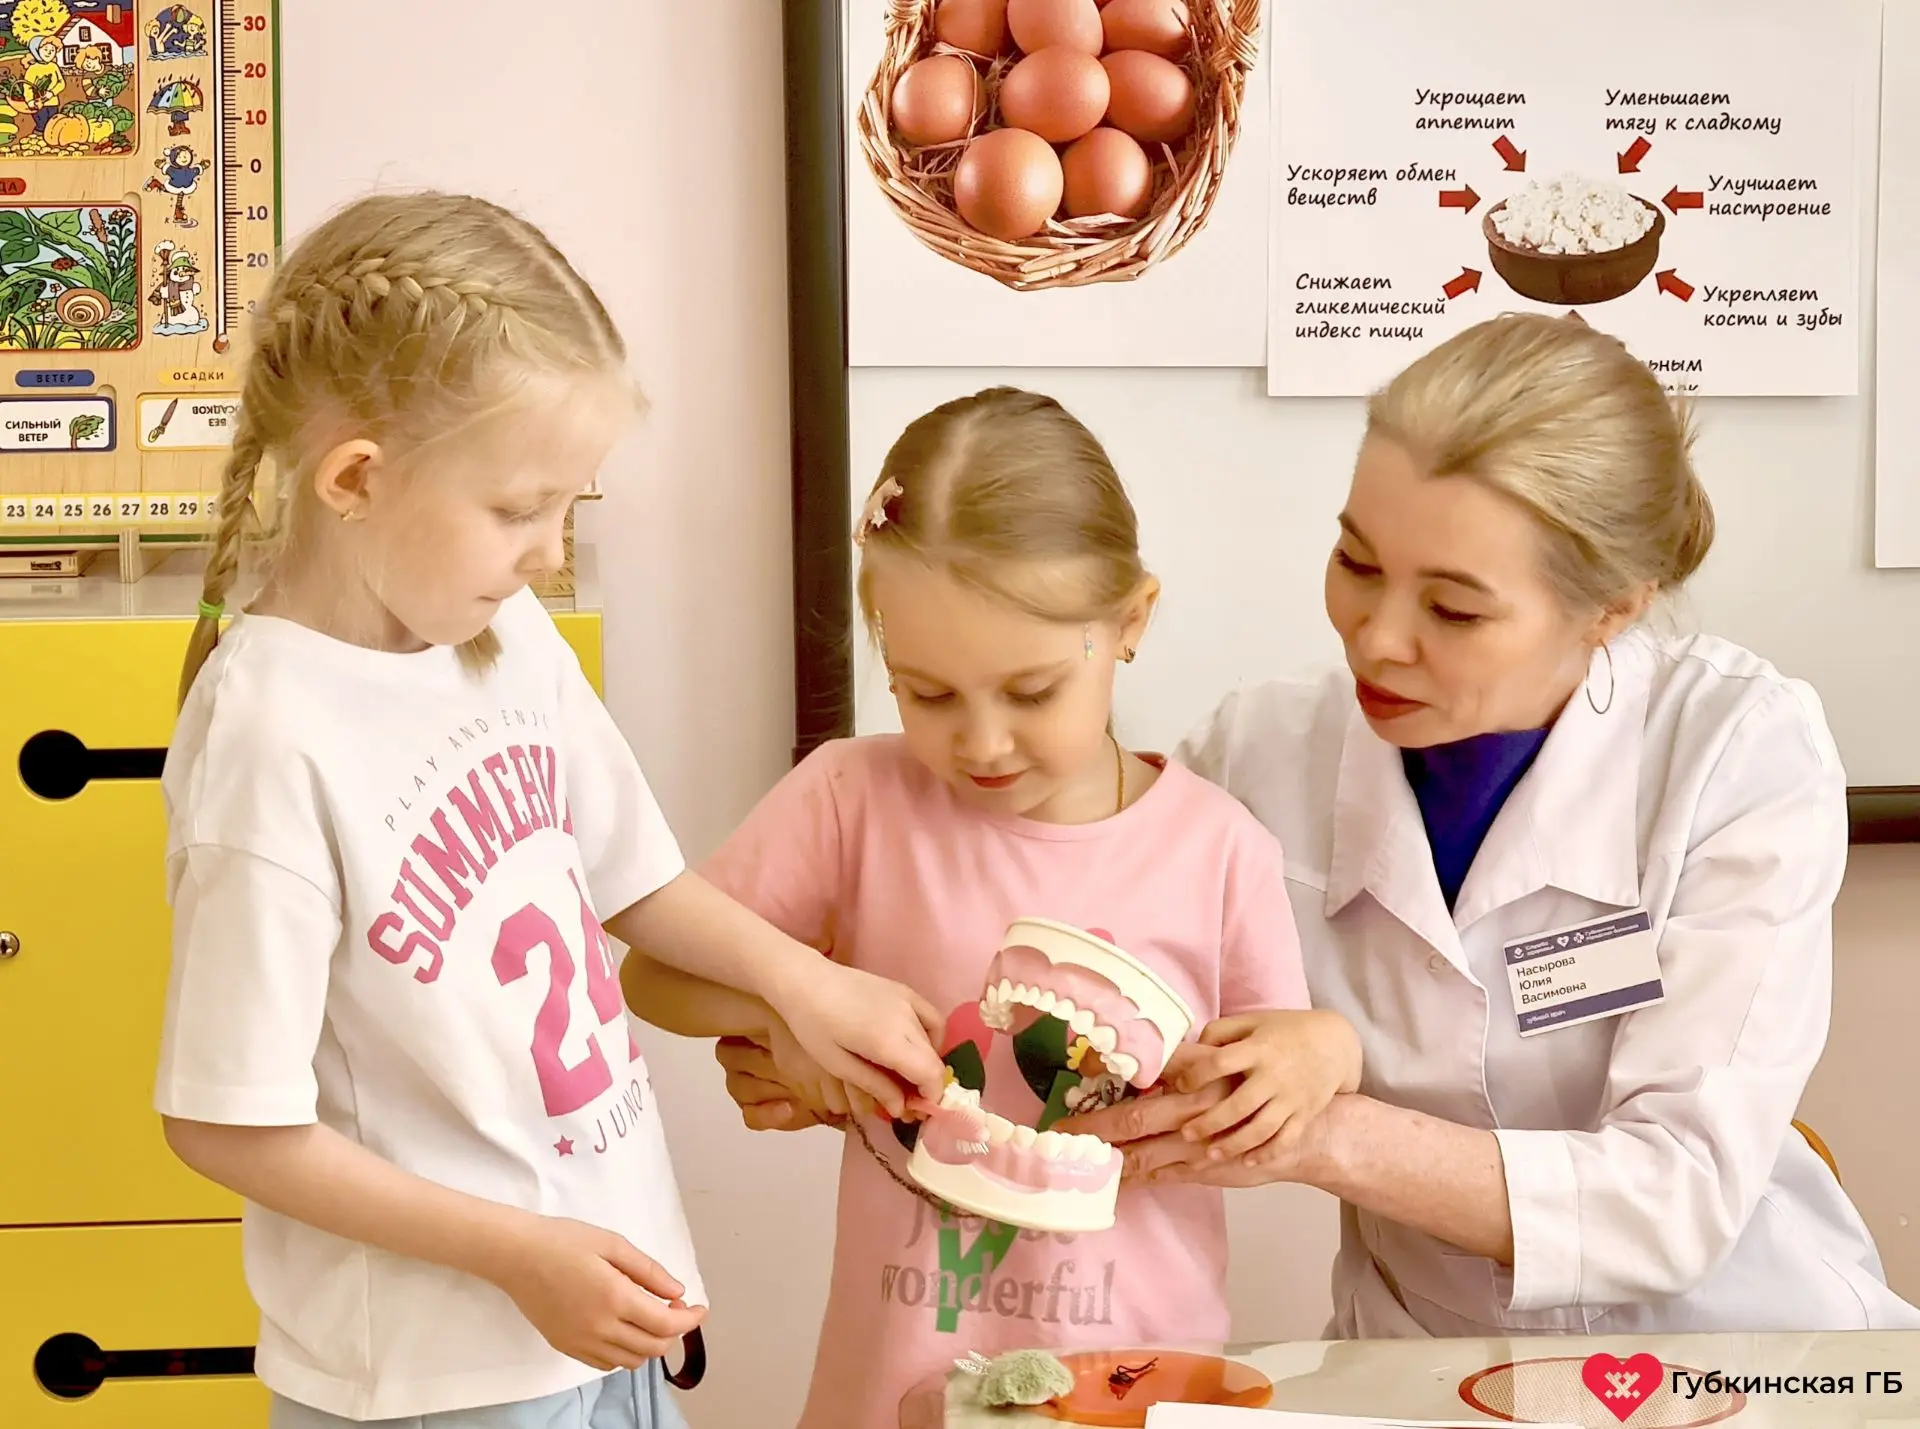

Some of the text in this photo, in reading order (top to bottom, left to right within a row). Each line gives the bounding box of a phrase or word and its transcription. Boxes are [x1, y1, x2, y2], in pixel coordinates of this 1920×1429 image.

[244, 16, 266, 31] 30
[244, 63, 267, 78] 20
[1414, 88, 1526, 111] Укрощает
[1604, 88, 1731, 106] Уменьшает
[245, 110, 267, 125] 10
[1415, 115, 1515, 129] аппетит
[1605, 112, 1782, 135] тягу к сладкому
[250, 158, 262, 173] 0
[1286, 163, 1457, 187] Ускоряет обмен
[1708, 174, 1818, 195] Улучшает
[1287, 187, 1377, 208] веществ
[247, 206, 268, 220] 10
[1709, 202, 1832, 221] настроение
[247, 253, 269, 267] 20
[1295, 273, 1392, 290] Снижает
[1702, 285, 1819, 308] Укрепляет
[1295, 297, 1446, 315] гликемический
[1703, 307, 1843, 331] кости и зубы
[1295, 321, 1424, 341] индекс пищи
[35, 373, 75, 383] ВЕТЕР
[172, 371, 225, 382] ОСАДКИ
[5, 418, 61, 430] СИЛЬНЫЙ
[18, 432, 48, 442] ВЕТЕР
[6, 504, 25, 518] 23
[35, 504, 54, 518] 24
[64, 504, 83, 518] 25
[92, 504, 112, 518] 26
[121, 503, 140, 517] 27
[150, 503, 169, 516] 28
[179, 503, 197, 516] 29
[385, 757, 440, 832] PLAY
[448, 717, 489, 752] AND
[1517, 956, 1576, 978] Насырова
[1519, 976, 1552, 991] Юлия
[1521, 981, 1587, 1004] Васимовна
[881, 1253, 1116, 1326] wonderful
